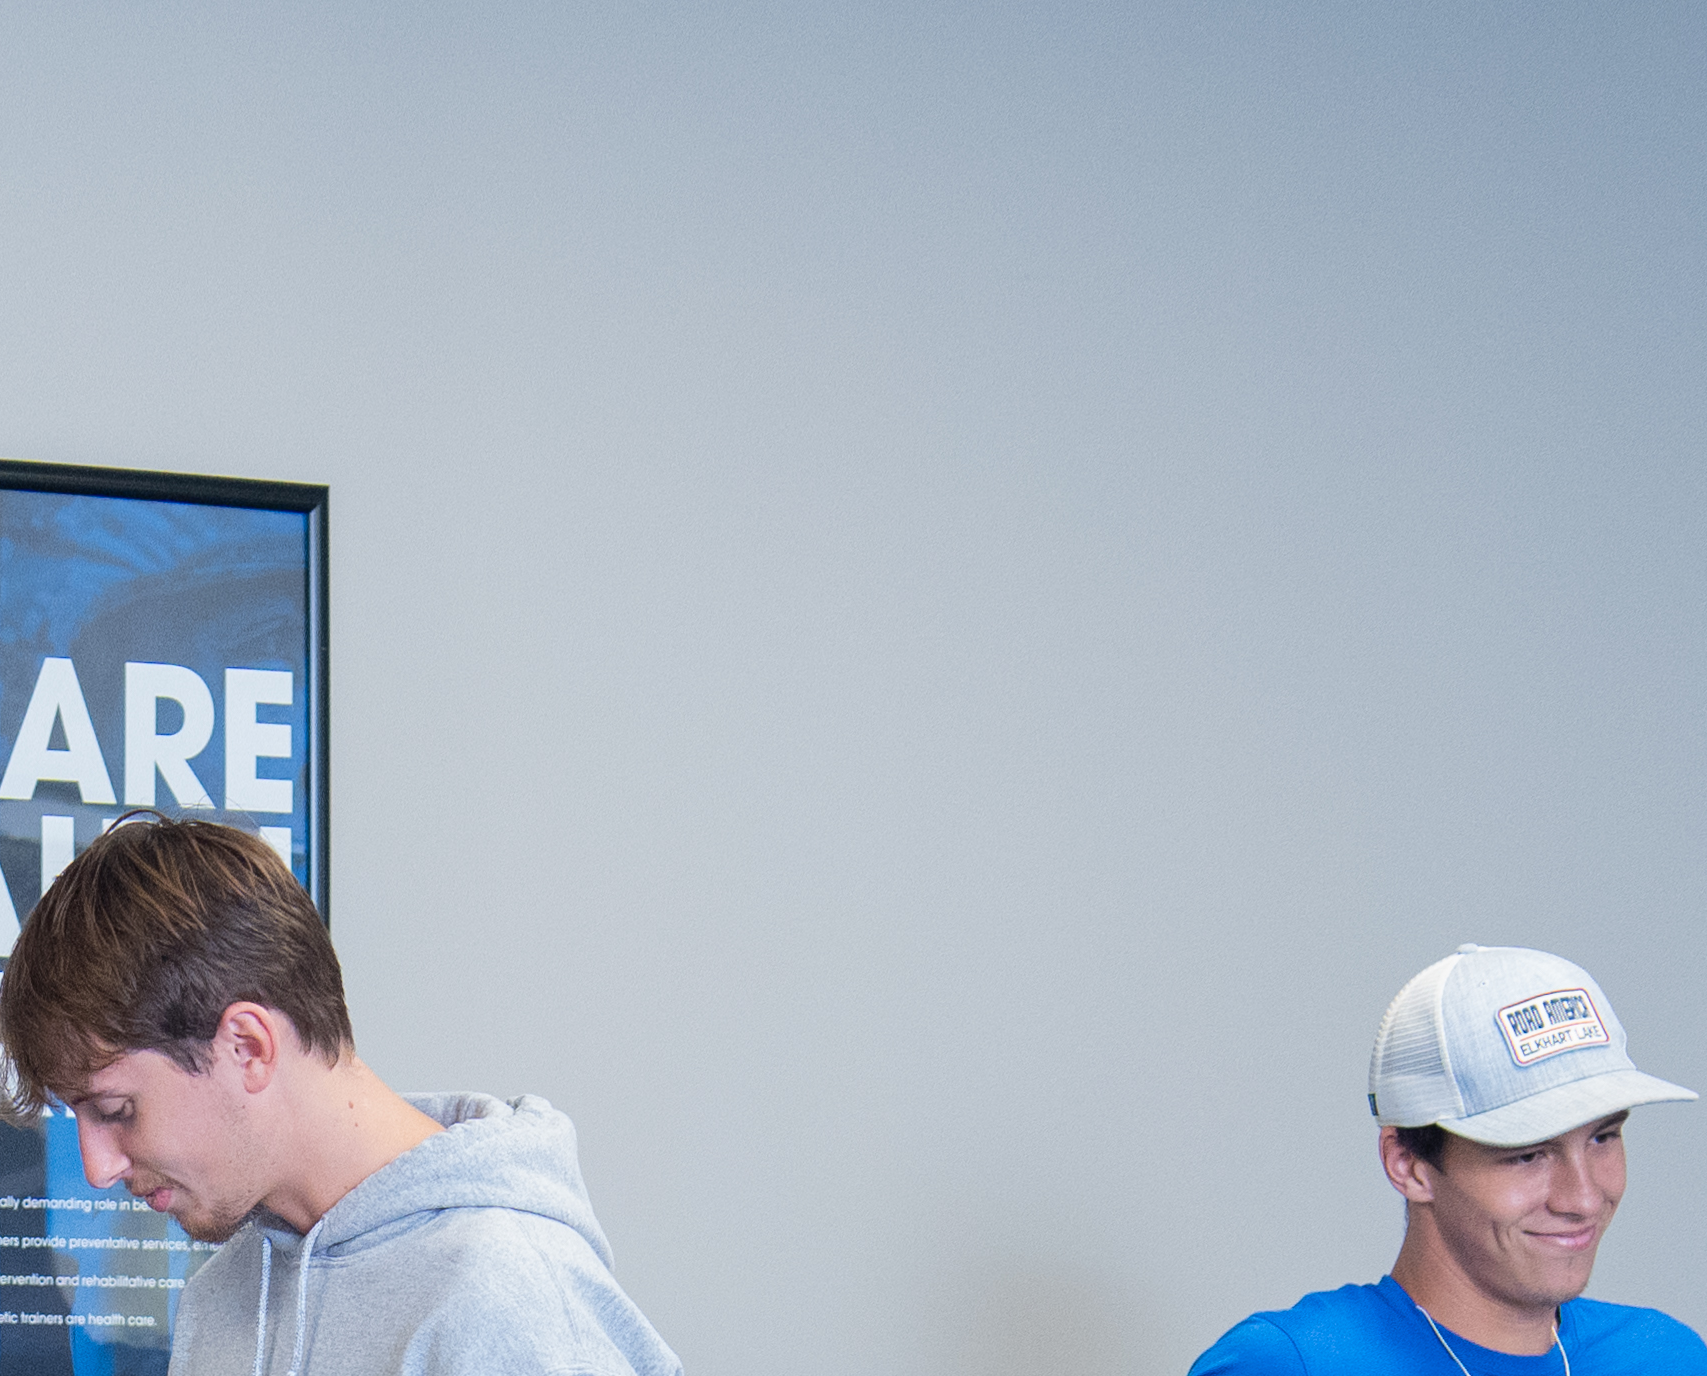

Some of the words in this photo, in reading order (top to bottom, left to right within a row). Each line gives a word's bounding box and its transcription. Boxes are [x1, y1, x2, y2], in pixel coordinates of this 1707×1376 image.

[22, 1196, 92, 1212] demanding
[94, 1198, 116, 1210] role
[119, 1199, 130, 1211] in
[21, 1235, 66, 1250] provide
[69, 1236, 140, 1251] preventative
[142, 1238, 191, 1252] services,
[56, 1274, 79, 1287] and
[81, 1275, 156, 1288] rehabilitative
[21, 1312, 63, 1325] trainers
[66, 1314, 85, 1325] are
[88, 1313, 125, 1326] health
[128, 1315, 157, 1326] care.
